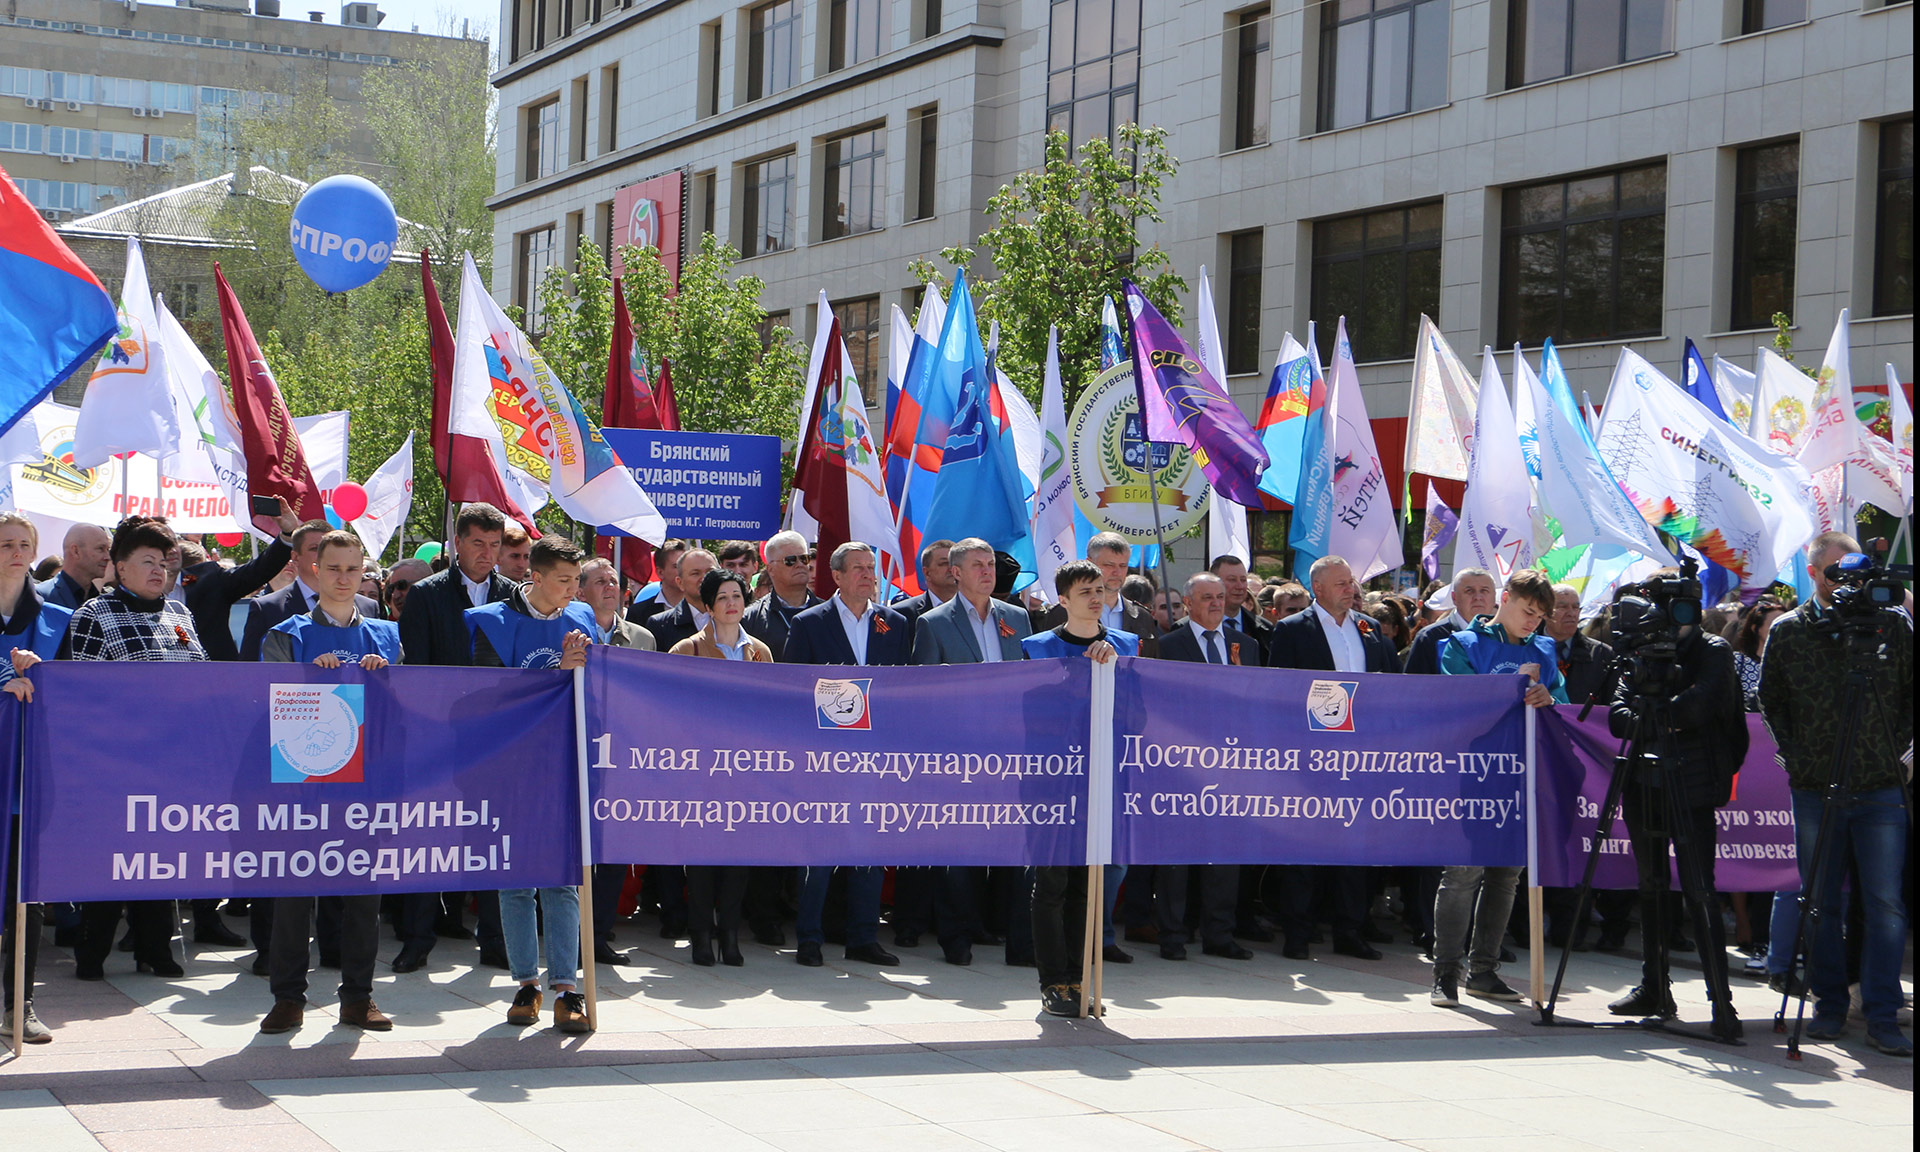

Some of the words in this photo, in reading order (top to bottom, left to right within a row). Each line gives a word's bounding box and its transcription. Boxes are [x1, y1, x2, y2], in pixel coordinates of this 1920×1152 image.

[290, 219, 395, 264] СПРОФ
[1075, 369, 1134, 438] ГОСУДАРСТВЕНН
[650, 441, 730, 463] Брянский
[1071, 443, 1089, 500] БРЯНСКИЙ
[628, 467, 762, 487] осударственный
[648, 492, 741, 511] ниверситет
[685, 517, 702, 527] И.Г.
[705, 518, 761, 530] Петровского
[275, 690, 321, 698] Федерация
[592, 733, 617, 769] 1
[629, 747, 701, 771] мая
[710, 749, 795, 777] день
[805, 744, 1085, 783] международной
[1119, 735, 1300, 773] Достойная
[1308, 749, 1525, 782] зарплата-путь
[126, 795, 240, 833] Пока
[258, 803, 329, 831] мы
[345, 798, 501, 836] едины,
[593, 798, 850, 832] солидарности
[860, 795, 1077, 833] трудящихся!
[1123, 792, 1142, 815] к
[1150, 784, 1364, 828] стабильному
[1371, 787, 1521, 829] обществу!
[113, 852, 187, 881] мы
[205, 835, 511, 882] непобедимы!
